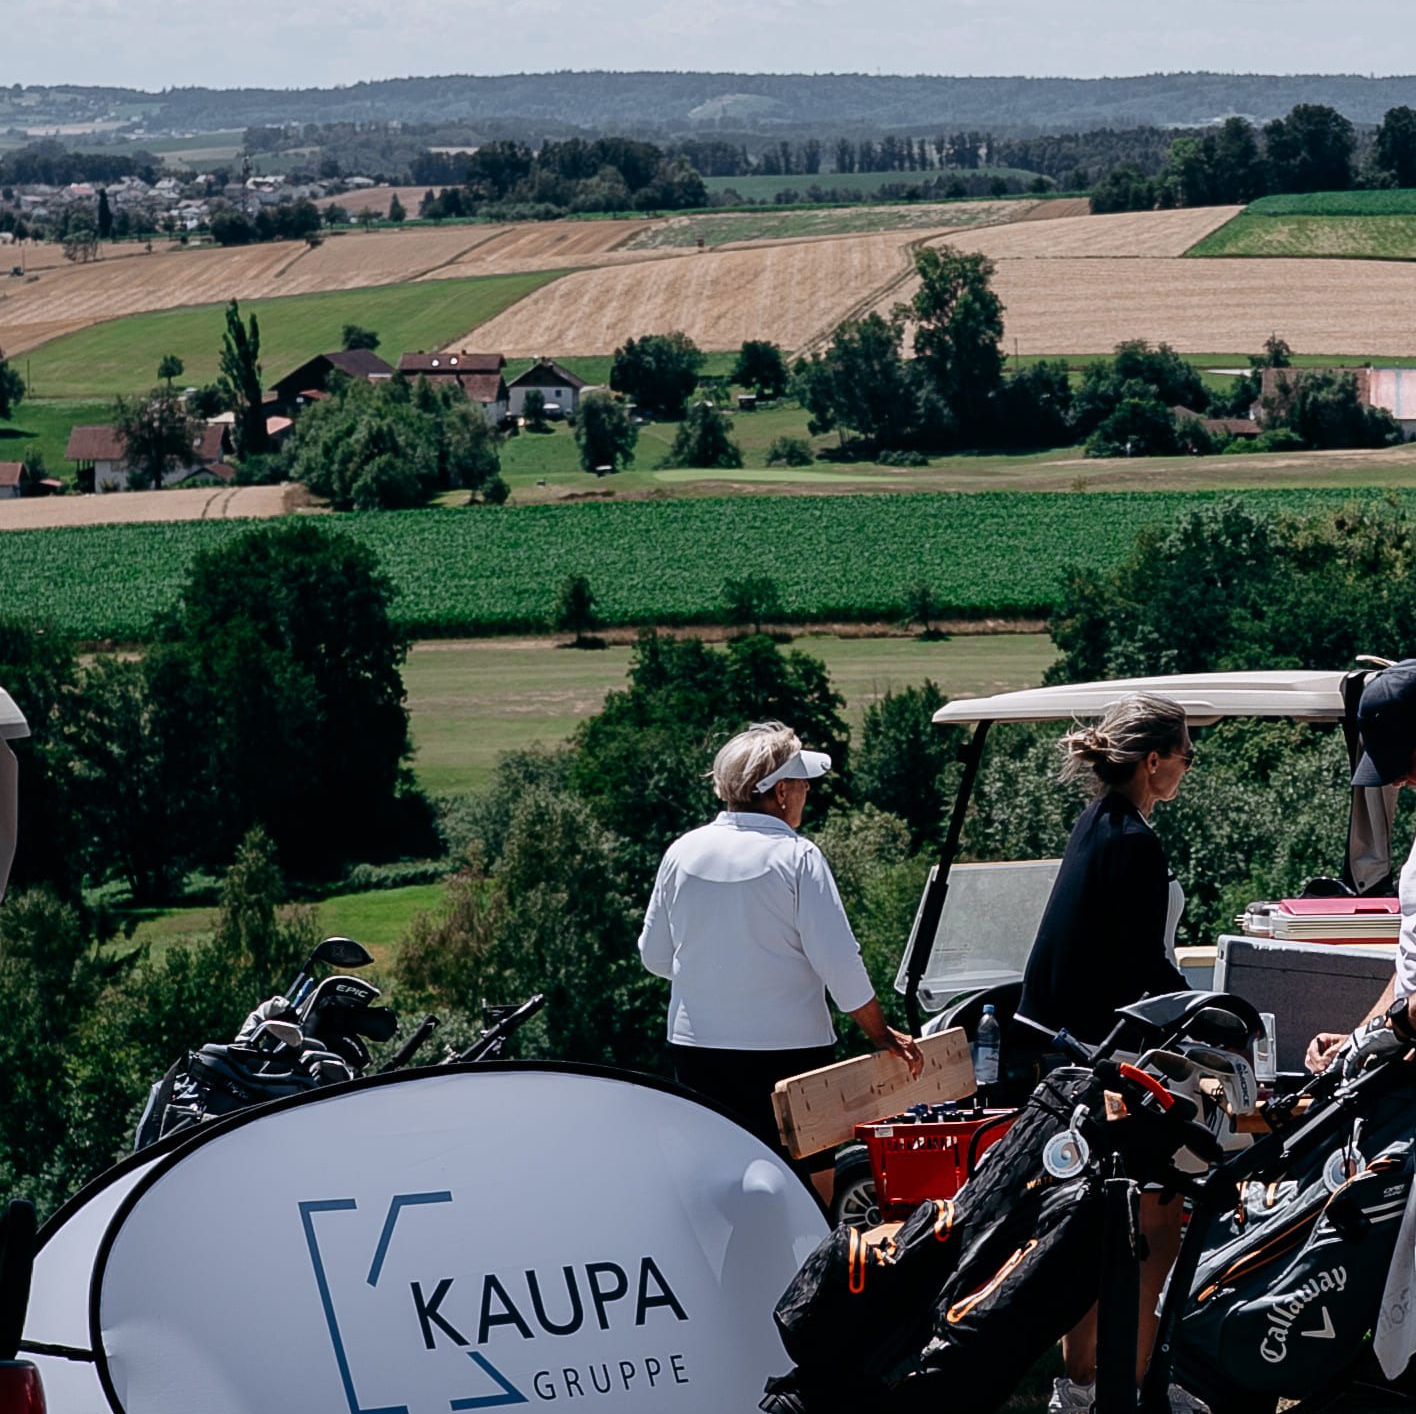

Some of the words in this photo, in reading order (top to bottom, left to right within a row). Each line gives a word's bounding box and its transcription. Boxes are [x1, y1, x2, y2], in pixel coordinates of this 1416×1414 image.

[335, 984, 369, 998] EPIC
[411, 1257, 689, 1350] KAUPA
[1260, 1265, 1347, 1363] Callaway
[533, 1354, 689, 1401] GRUPPE
